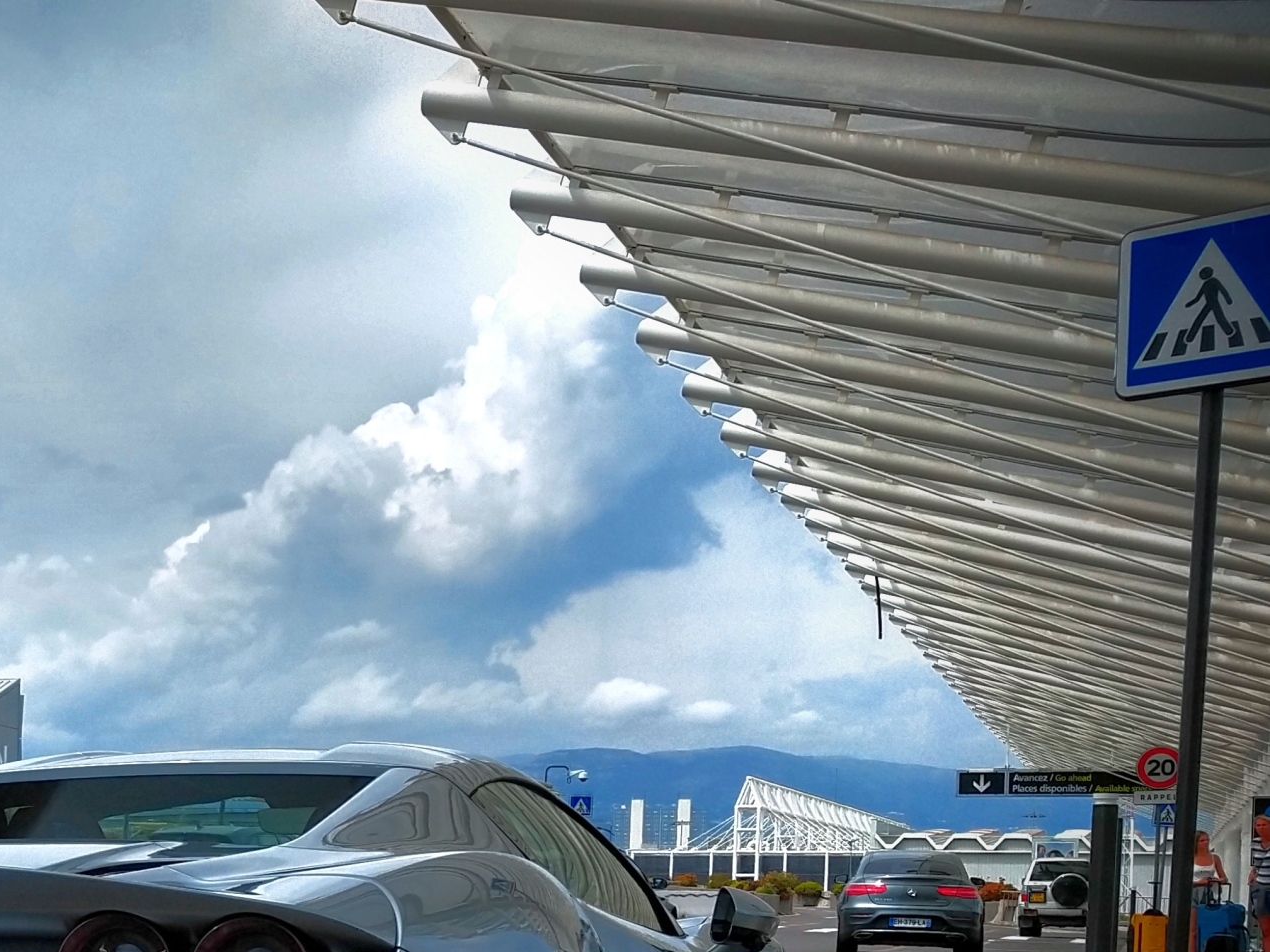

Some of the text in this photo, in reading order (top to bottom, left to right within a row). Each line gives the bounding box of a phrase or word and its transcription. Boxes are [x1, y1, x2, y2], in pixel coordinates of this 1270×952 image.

[1147, 759, 1175, 776] 20
[1013, 774, 1048, 782] Avancez
[1055, 774, 1067, 782] Go
[1068, 774, 1092, 782] ahead
[1012, 784, 1038, 793] Places
[1039, 784, 1087, 794] disponibles
[1095, 784, 1130, 792] Available
